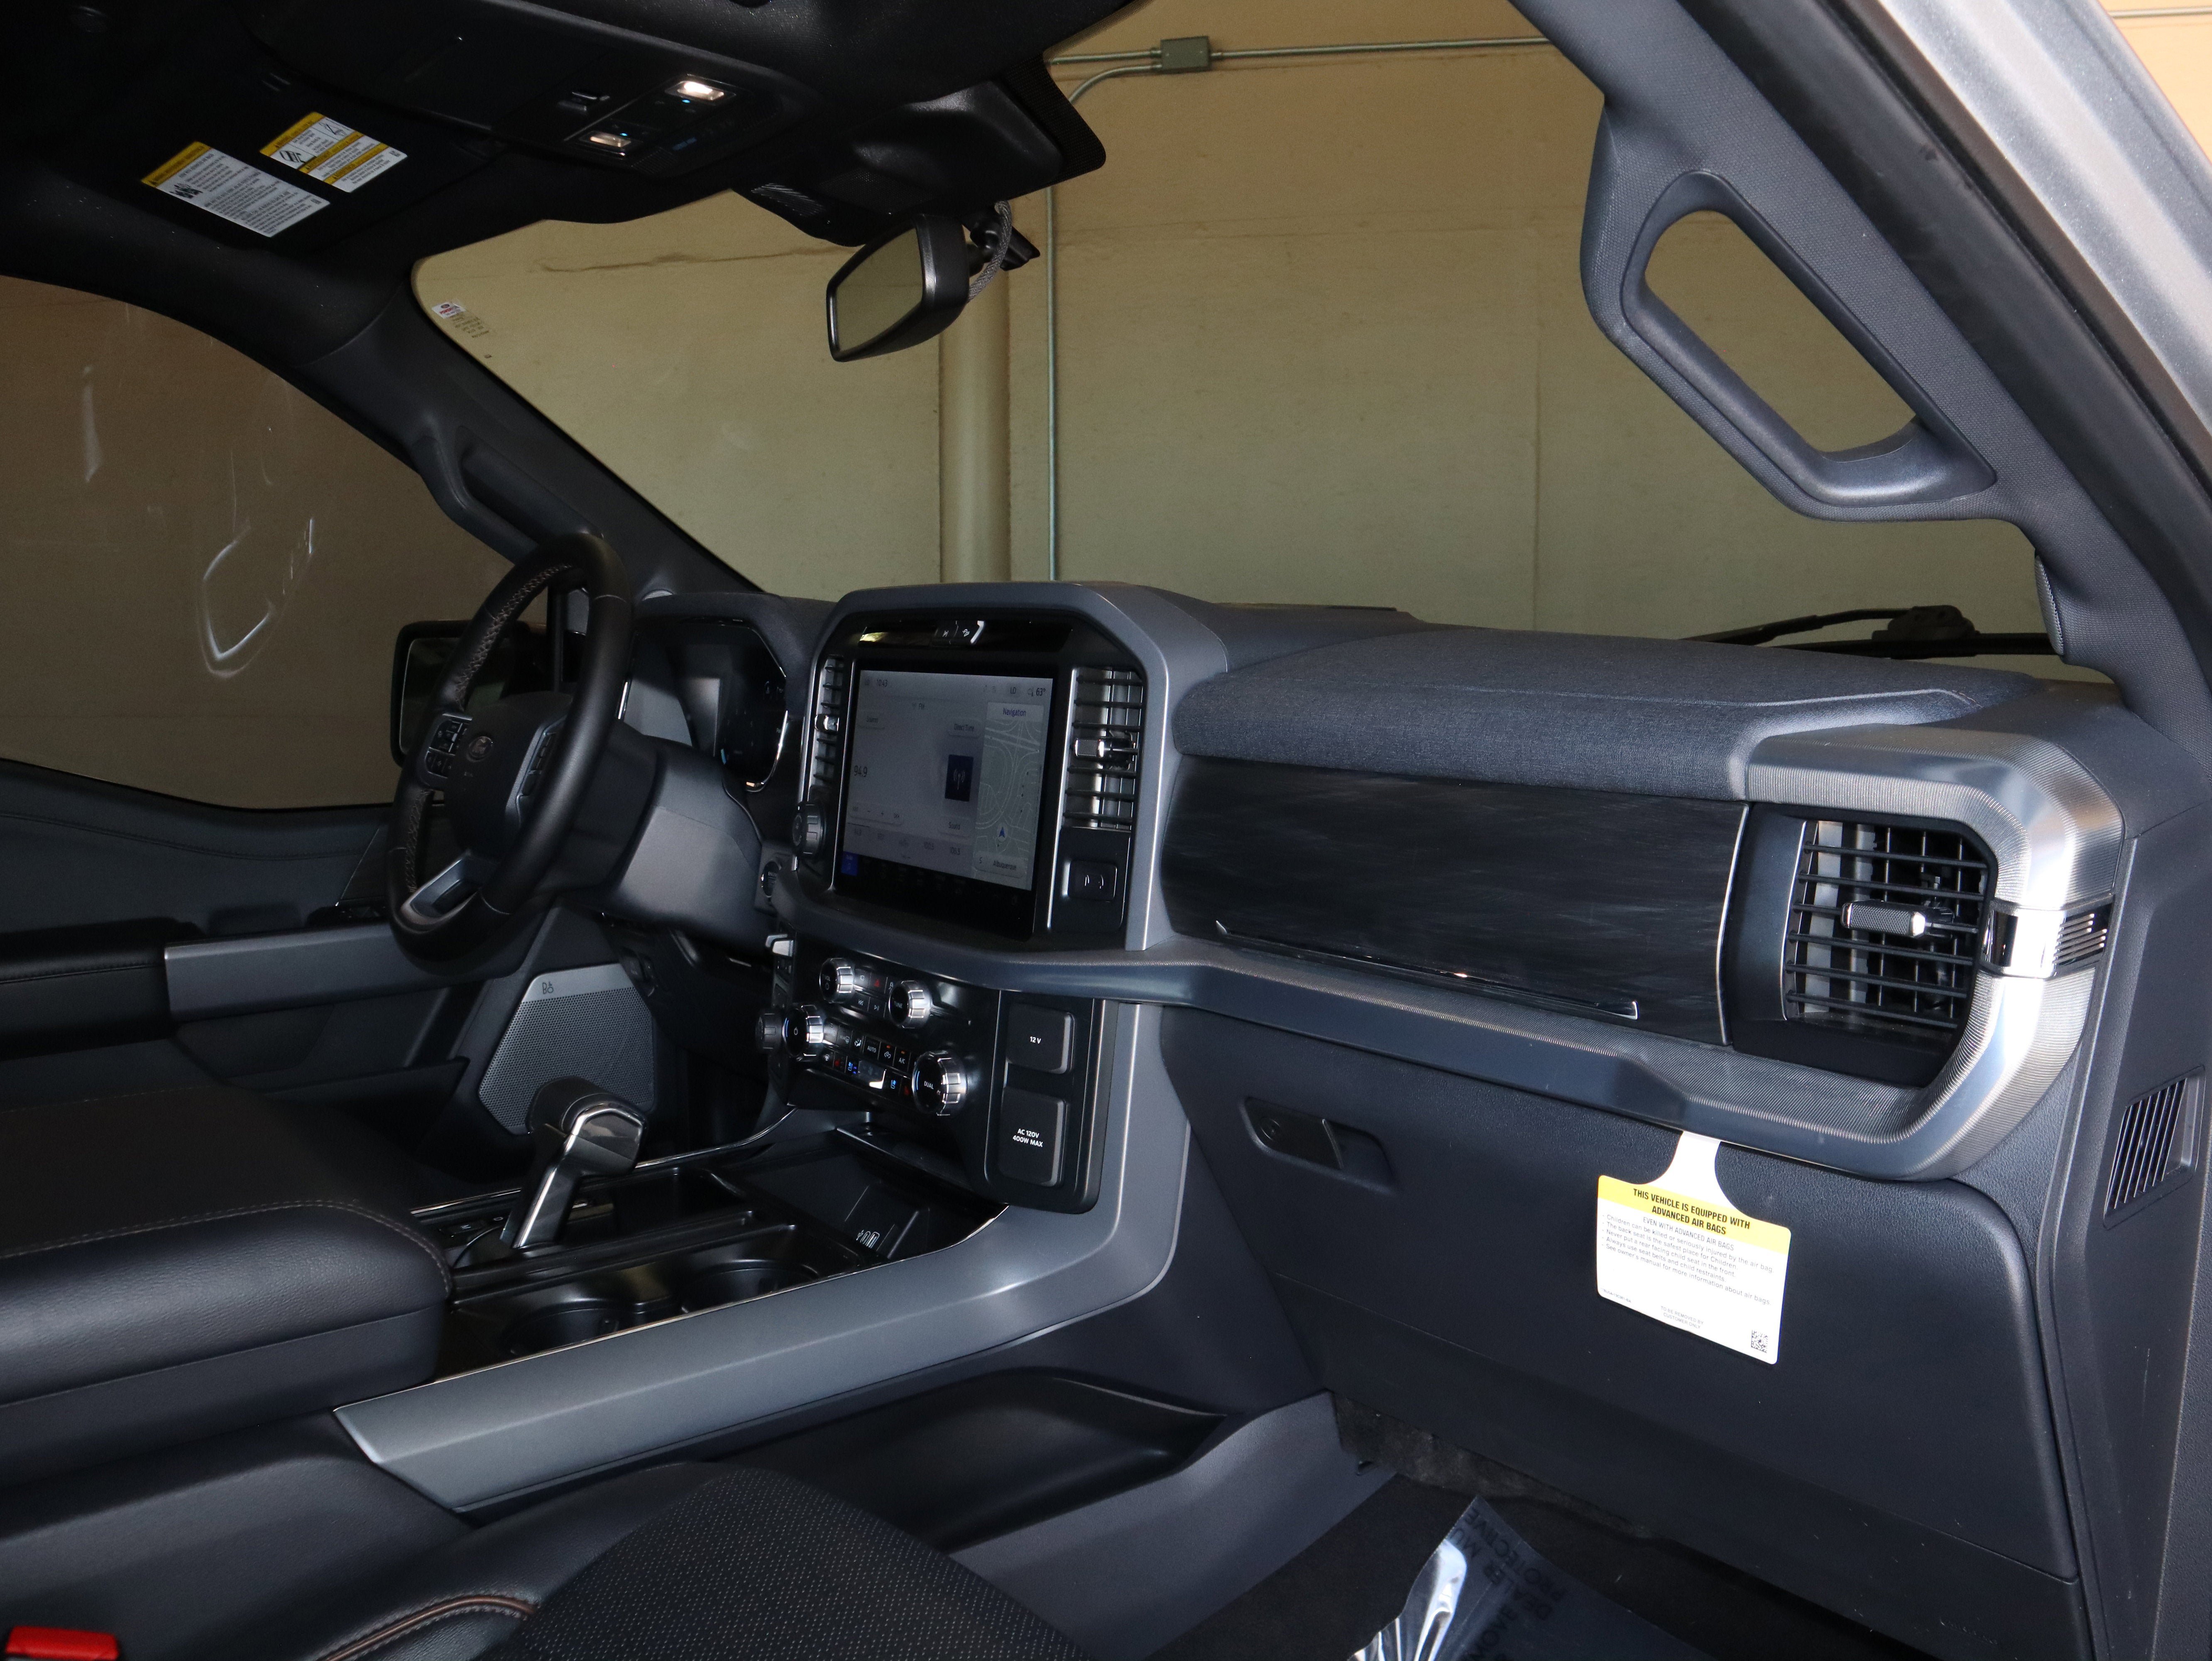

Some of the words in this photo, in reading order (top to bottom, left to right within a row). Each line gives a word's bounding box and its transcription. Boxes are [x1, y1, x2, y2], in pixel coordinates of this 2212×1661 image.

[1035, 687, 1046, 696] 63°
[1003, 708, 1026, 717] Navigation
[854, 765, 868, 777] 94.9
[993, 860, 1017, 871] Albuquerque
[924, 1080, 934, 1090] DUAL
[1012, 1135, 1028, 1144] 400W
[1030, 1139, 1043, 1148] MAX
[1026, 1129, 1040, 1139] 120V
[1633, 1188, 1649, 1200] THIS
[1651, 1193, 1680, 1209] VEHICLE
[1681, 1203, 1688, 1212] IS
[1691, 1205, 1728, 1223] EQUIPPED
[1730, 1217, 1750, 1230] WITH
[1652, 1205, 1690, 1223] ADVANCED
[1691, 1218, 1704, 1228] AIR
[1706, 1222, 1726, 1235] BAGS
[1606, 1221, 1617, 1230] The
[1618, 1225, 1632, 1235] back
[1633, 1231, 1645, 1240] seat
[1664, 1242, 1681, 1252] safest
[1683, 1248, 1699, 1257] place
[1606, 1228, 1622, 1239] Never
[1652, 1244, 1669, 1257] facing
[1671, 1252, 1686, 1261] child
[1607, 1214, 1630, 1227] Children
[1652, 1229, 1668, 1239] killed
[1677, 1238, 1704, 1252] seriously
[1706, 1246, 1727, 1259] injured
[1729, 1254, 1737, 1262] by
[1643, 1216, 1657, 1227] EVEN
[1659, 1222, 1674, 1232] WITH
[1674, 1227, 1705, 1242] ADVANCED
[1706, 1237, 1716, 1246] AIR
[1718, 1240, 1734, 1251] BAGS
[1606, 1236, 1626, 1248] Always
[1652, 1252, 1666, 1262] belts
[1680, 1263, 1695, 1271] child
[1606, 1243, 1616, 1252] See
[1617, 1249, 1639, 1260] owner's
[1640, 1257, 1661, 1268] manual
[1672, 1268, 1688, 1277] more
[1689, 1272, 1723, 1289] information
[1725, 1286, 1742, 1296] about
[1663, 1312, 1688, 1325] CUSTOMER
[1674, 1311, 1697, 1323] REMOVED
[1464, 1507, 1568, 1602] PROTECTIVE
[1483, 1560, 1553, 1621] DEALER
